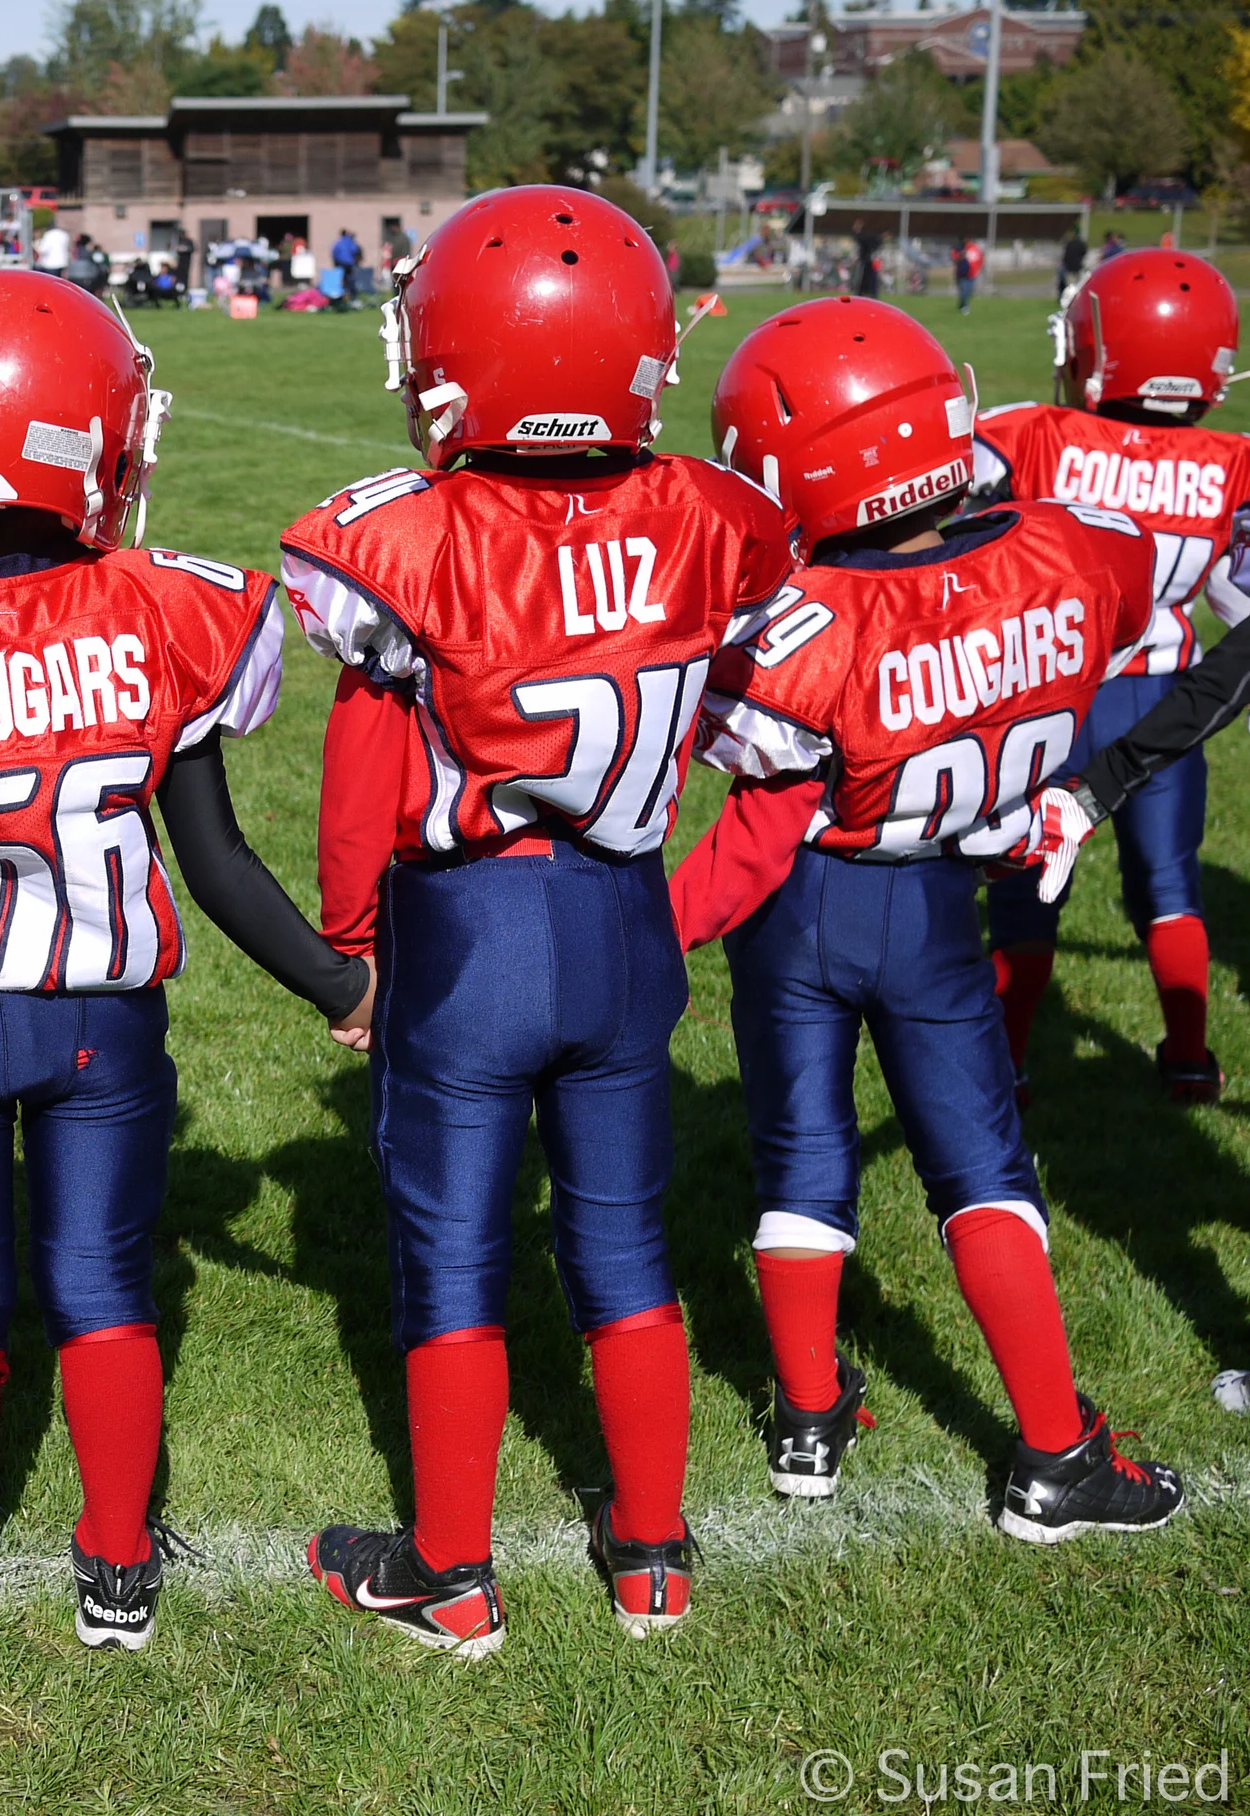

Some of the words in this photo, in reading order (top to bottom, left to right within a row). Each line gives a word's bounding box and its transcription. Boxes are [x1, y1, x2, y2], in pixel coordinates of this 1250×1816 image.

[516, 418, 599, 437] schutt
[864, 461, 964, 523] Riddell
[1053, 444, 1226, 518] COUGARS
[557, 536, 667, 637] LUZ
[878, 597, 1084, 732] COUGARS
[83, 1594, 149, 1624] Reebok
